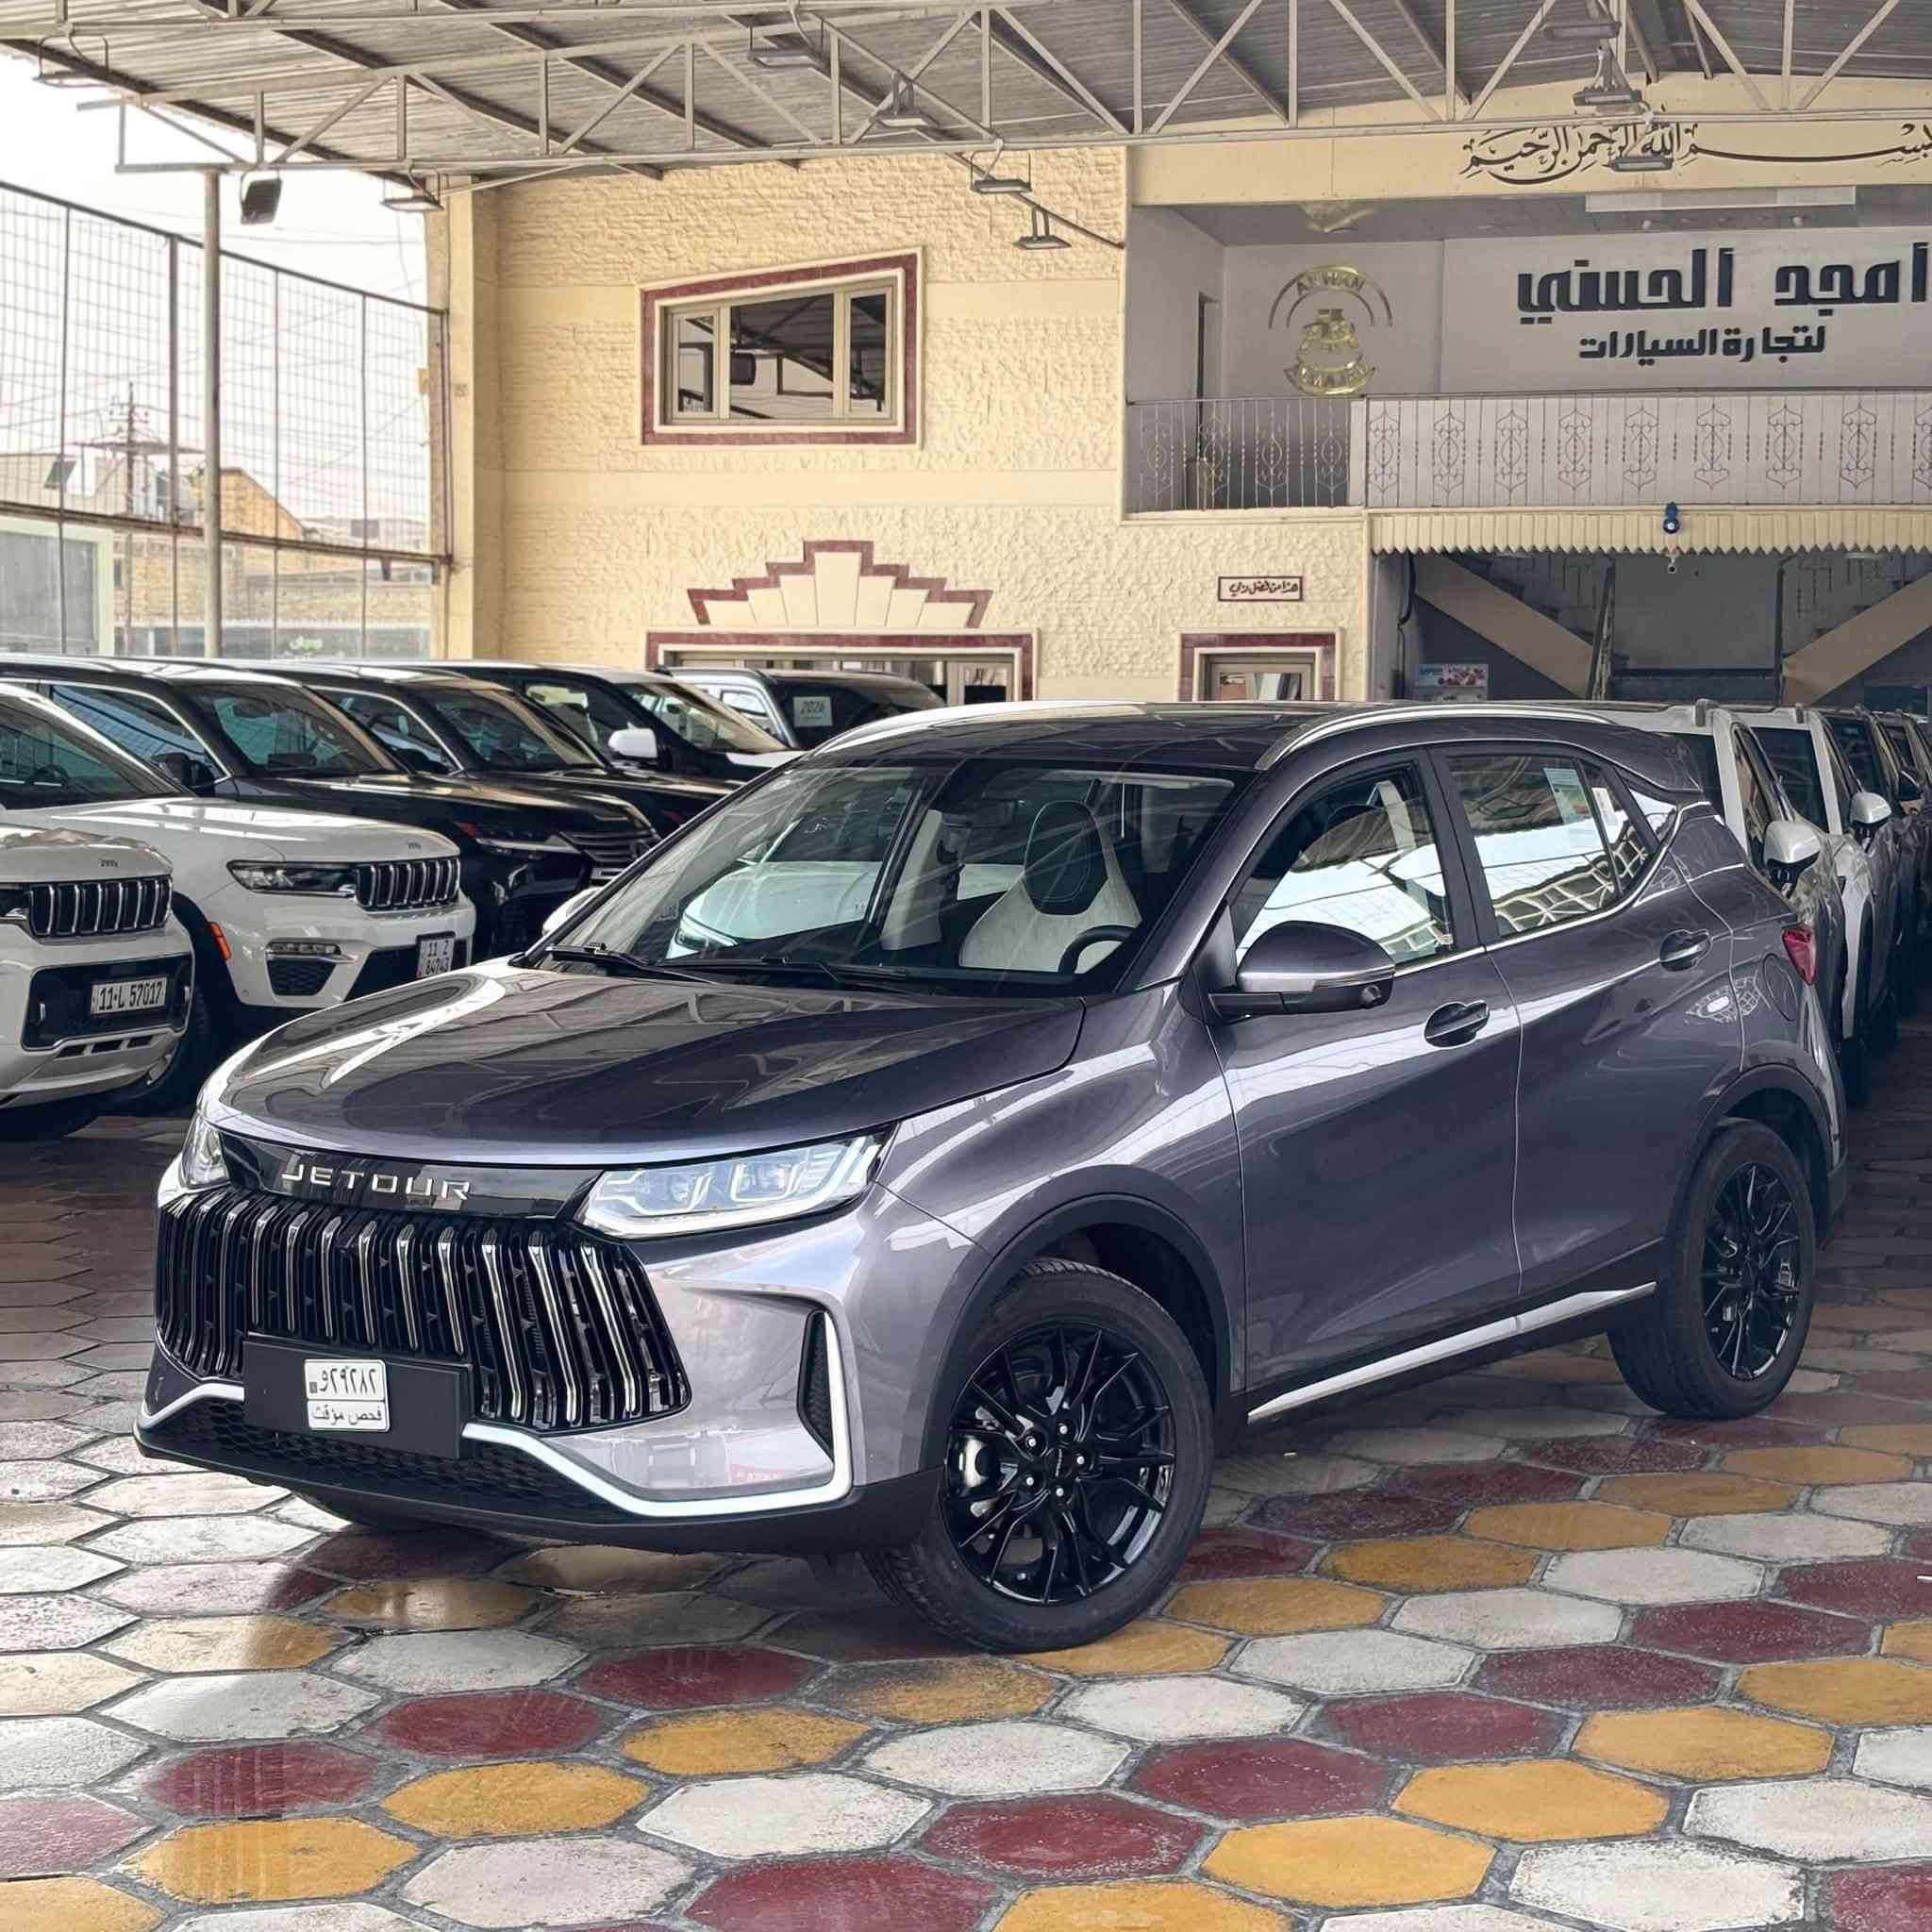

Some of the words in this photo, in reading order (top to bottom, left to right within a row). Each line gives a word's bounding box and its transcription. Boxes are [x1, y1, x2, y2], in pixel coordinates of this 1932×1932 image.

[1517, 246, 1735, 325] الحسني
[1578, 326, 1718, 366] السيارات
[1722, 325, 1827, 363] لتجارة
[129, 981, 162, 1008] 57017
[282, 1164, 470, 1201] JETOUR
[348, 1405, 382, 1425] فحص
